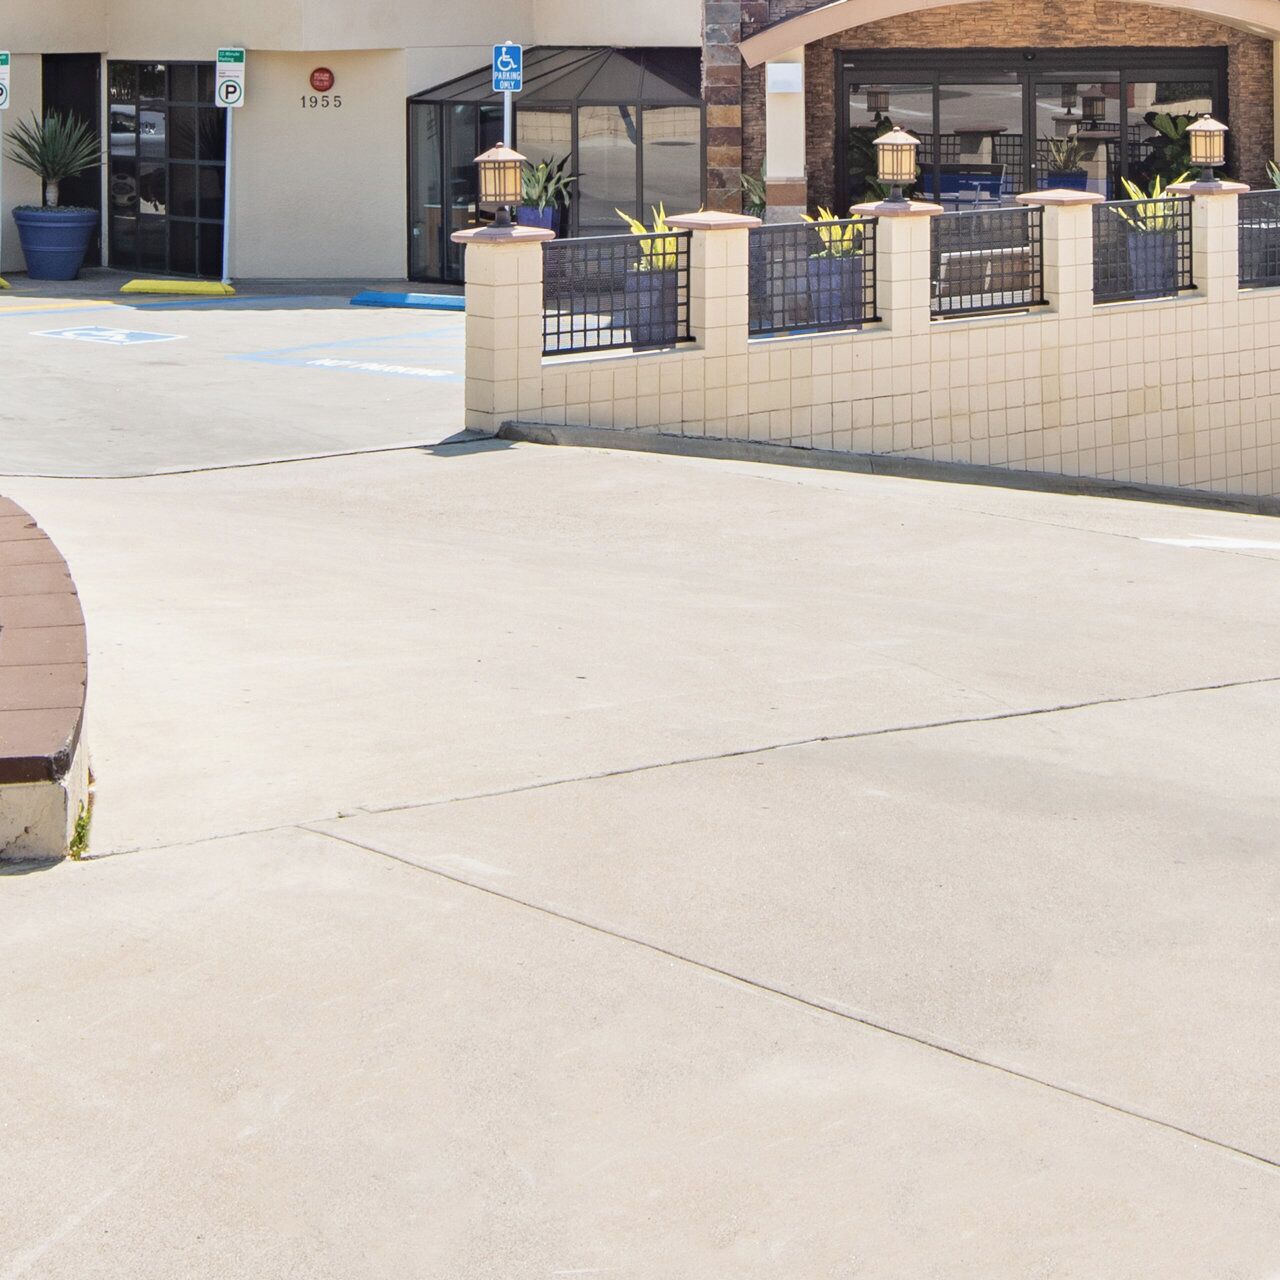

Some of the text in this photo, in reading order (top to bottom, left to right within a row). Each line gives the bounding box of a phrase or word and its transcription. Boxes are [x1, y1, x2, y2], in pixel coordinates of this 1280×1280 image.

[494, 71, 521, 81] PARKING
[500, 80, 516, 89] ONLY
[225, 84, 238, 100] P
[300, 95, 342, 108] 1955
